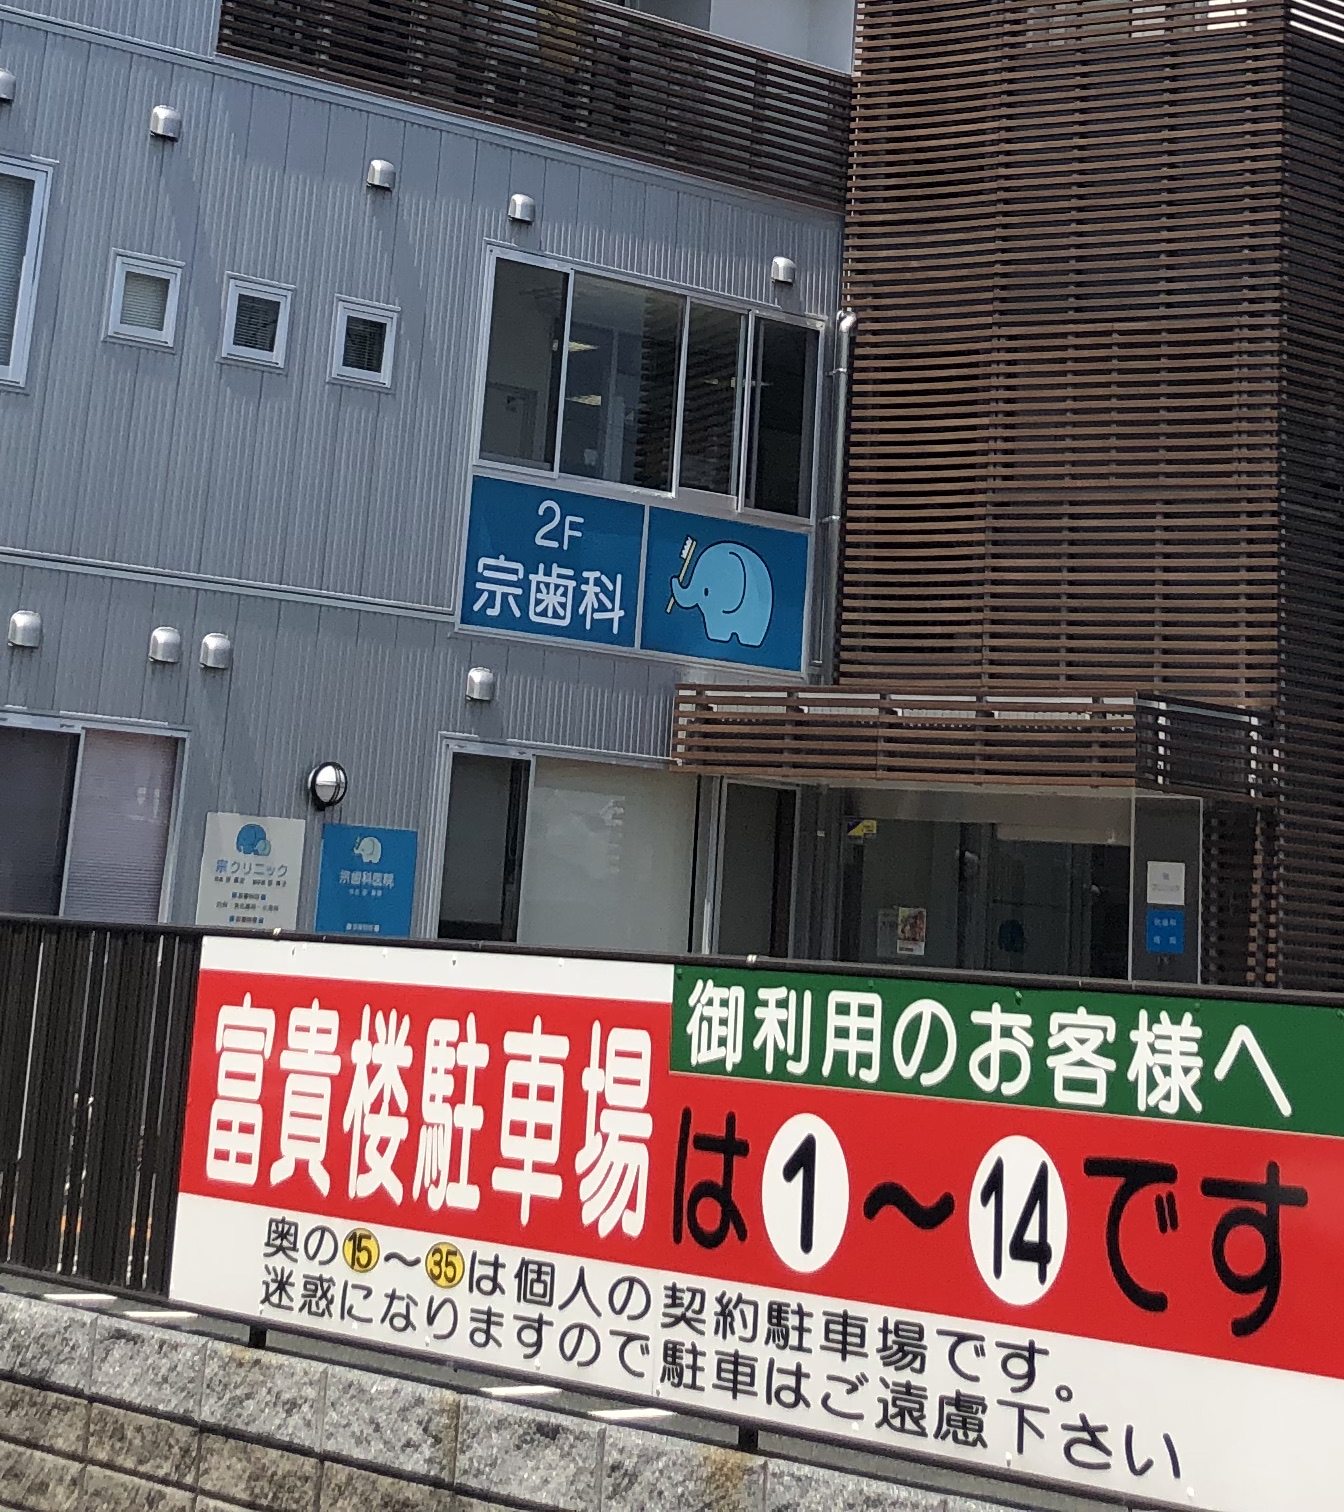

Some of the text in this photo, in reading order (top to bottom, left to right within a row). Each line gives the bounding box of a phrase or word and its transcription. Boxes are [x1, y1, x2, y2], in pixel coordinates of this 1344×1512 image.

[535, 500, 585, 550] 2F
[473, 555, 626, 635] 宗歯科
[206, 991, 653, 1238] 富貴楼駐車場
[686, 979, 1292, 1118] 御利用のお客様へ
[259, 1265, 1182, 1479] 迷惑になりますので駐車はご遠慮下さい
